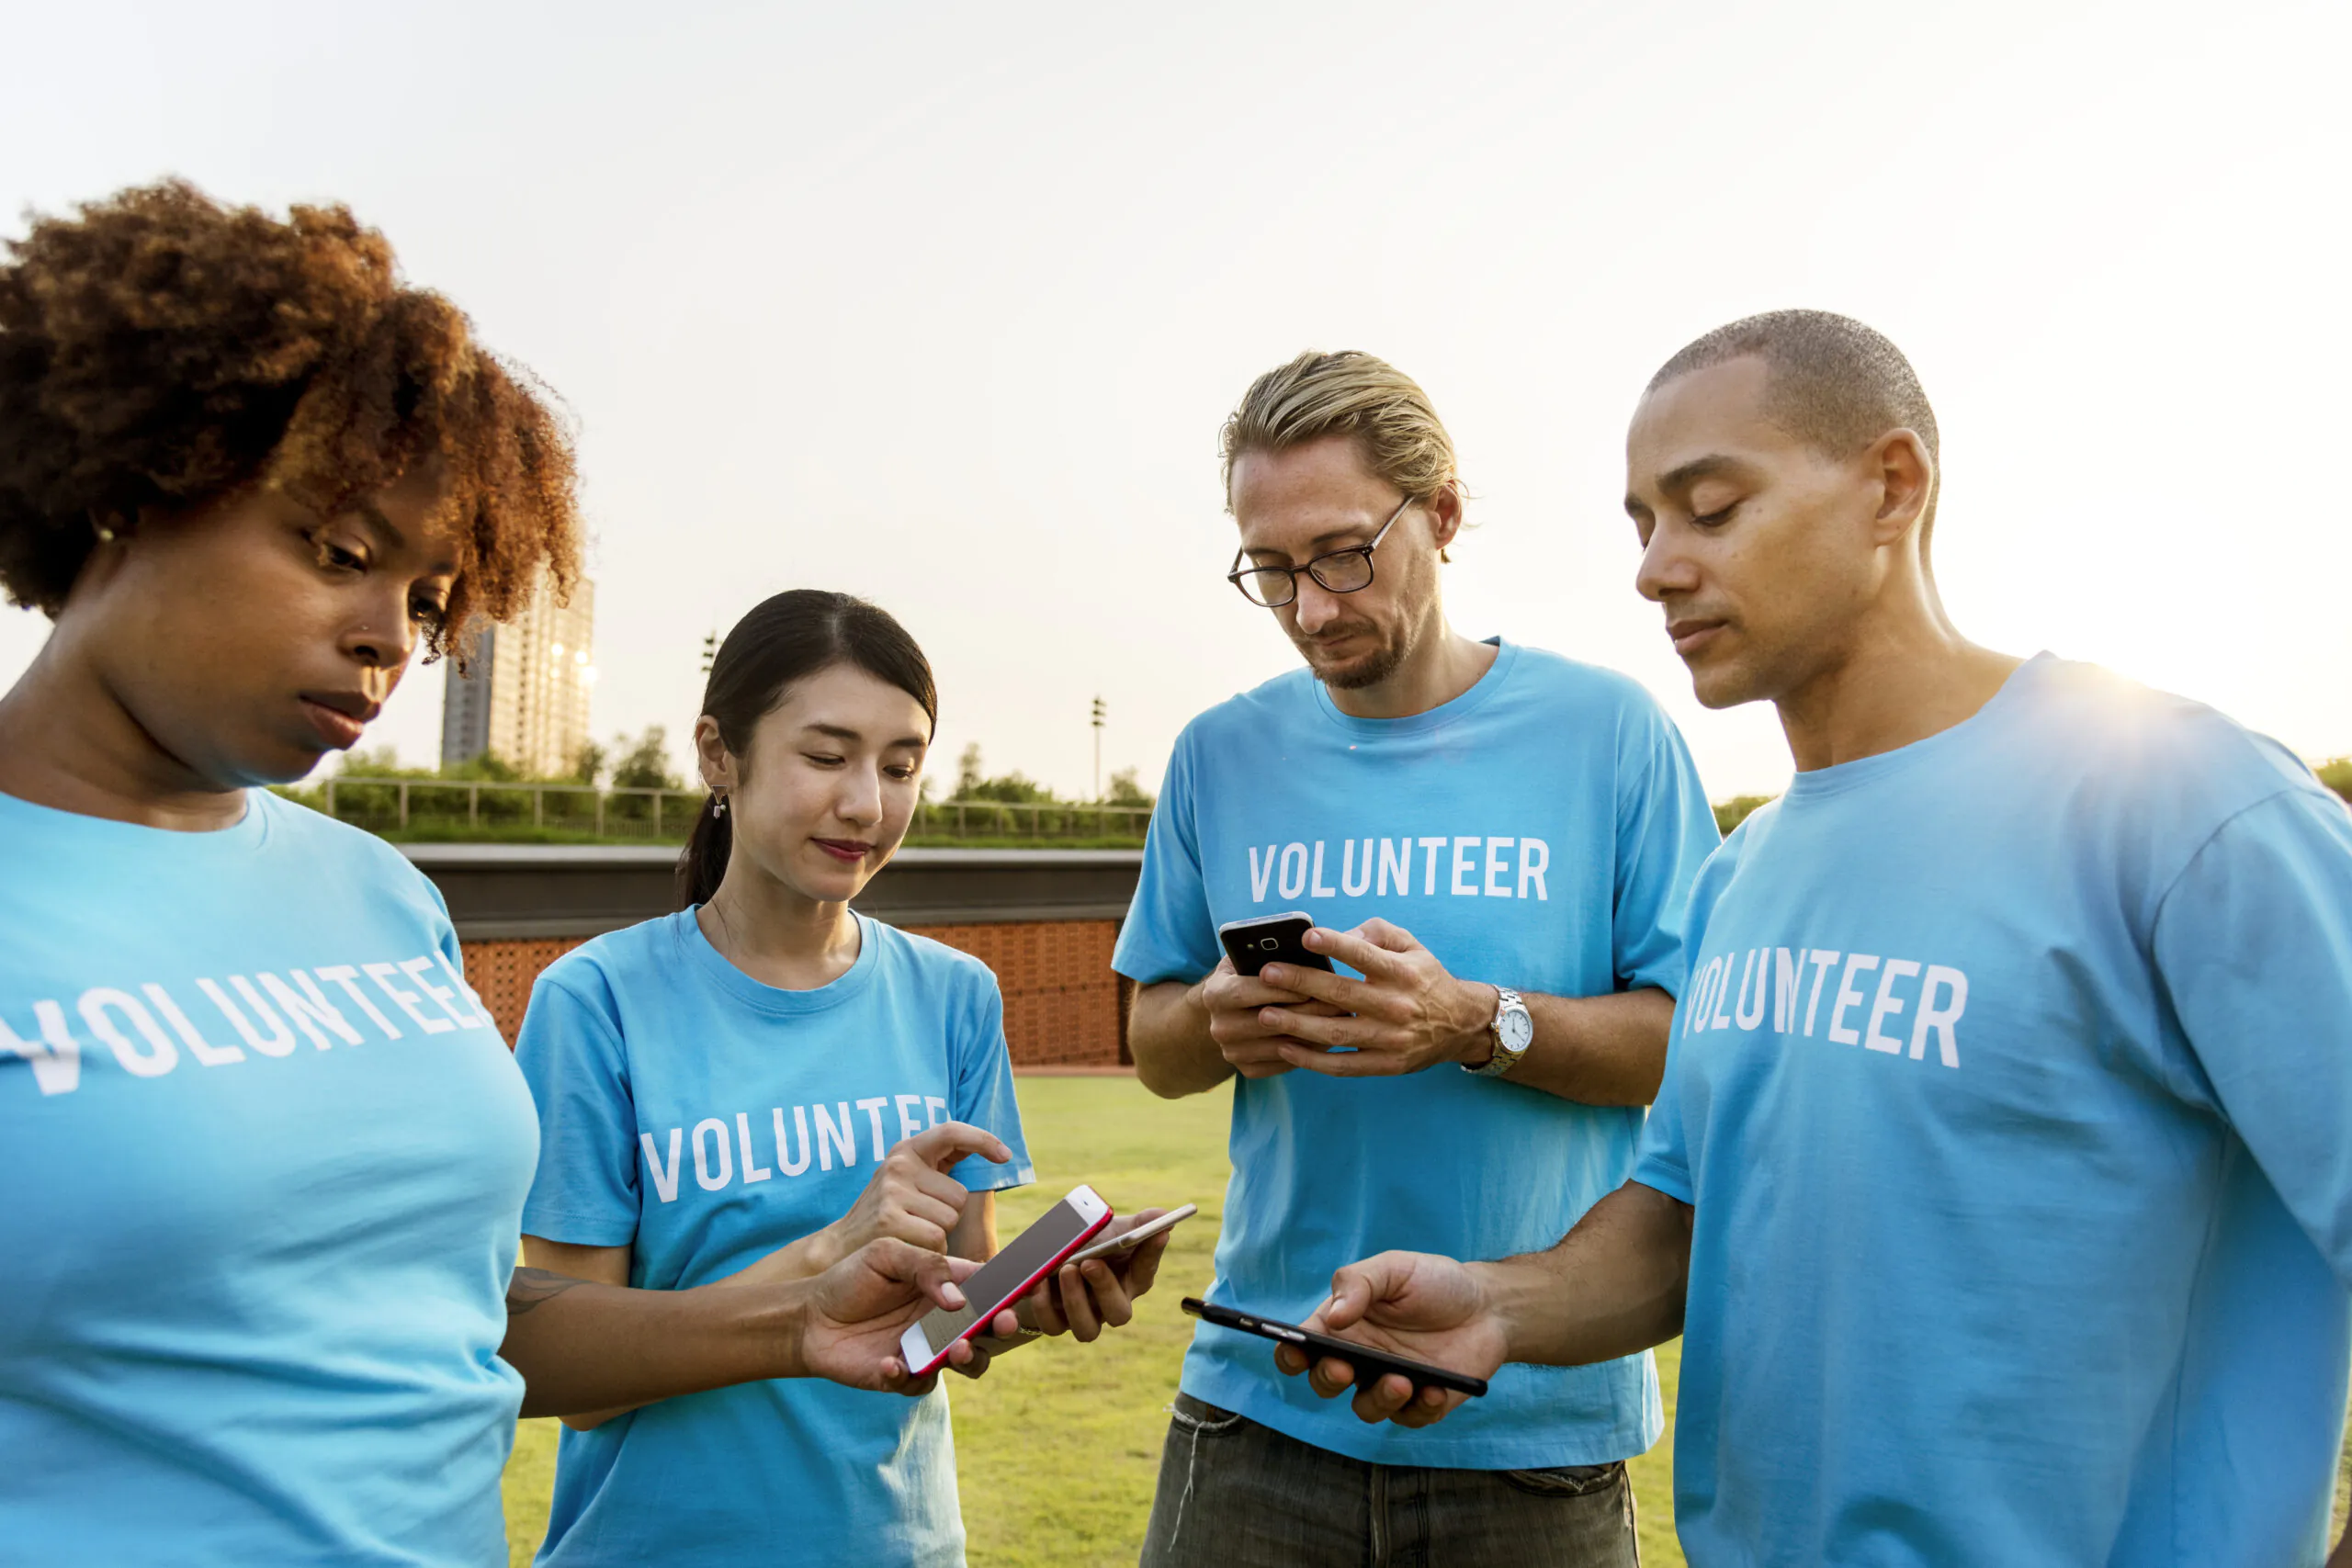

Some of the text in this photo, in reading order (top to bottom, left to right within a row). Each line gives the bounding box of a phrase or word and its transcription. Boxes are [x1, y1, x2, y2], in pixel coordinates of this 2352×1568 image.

[1249, 837, 1550, 903] VOLUNTEER
[1683, 947, 1968, 1068] VOLUNTEER
[640, 1094, 952, 1203] VOLUNTE
